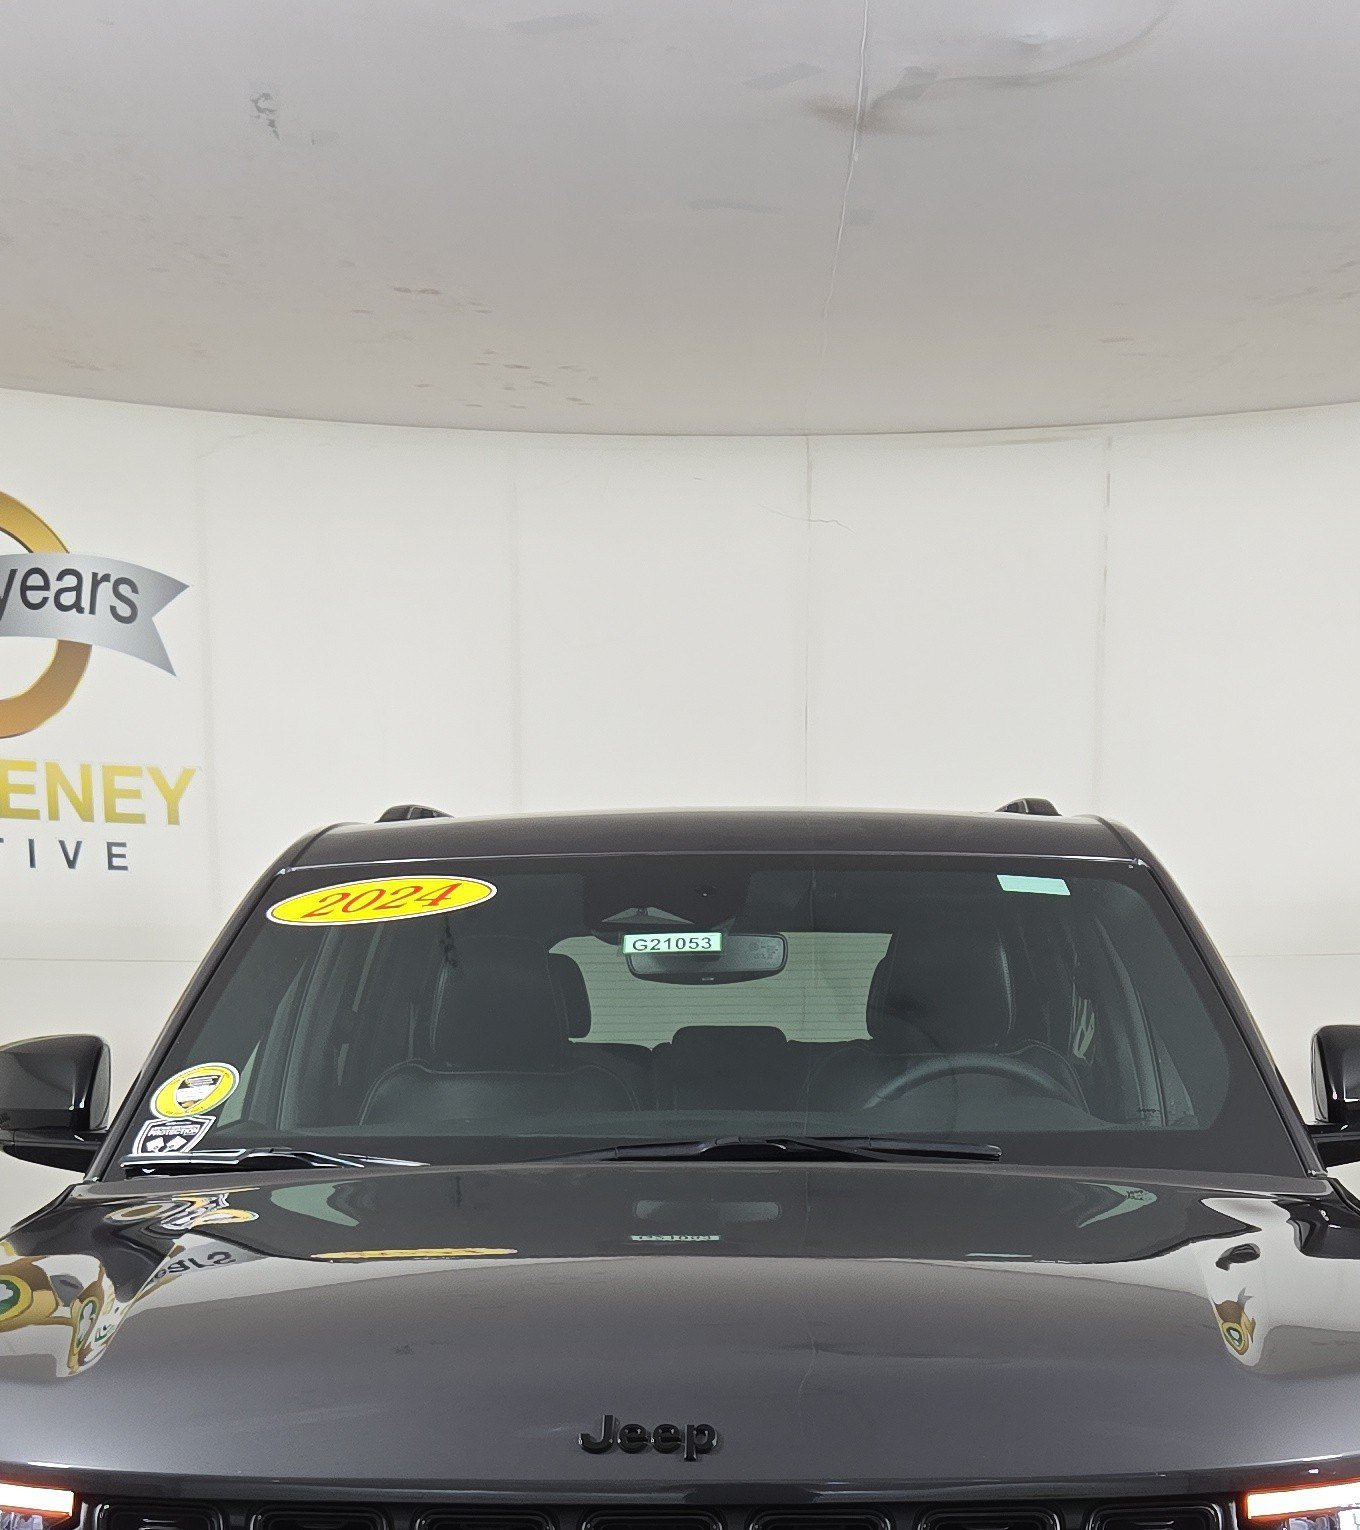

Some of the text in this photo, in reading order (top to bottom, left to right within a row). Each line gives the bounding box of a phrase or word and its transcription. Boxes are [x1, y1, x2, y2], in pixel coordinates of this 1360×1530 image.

[300, 883, 462, 918] 2024
[632, 937, 713, 951] G21053
[579, 1415, 718, 1461] Jeep
